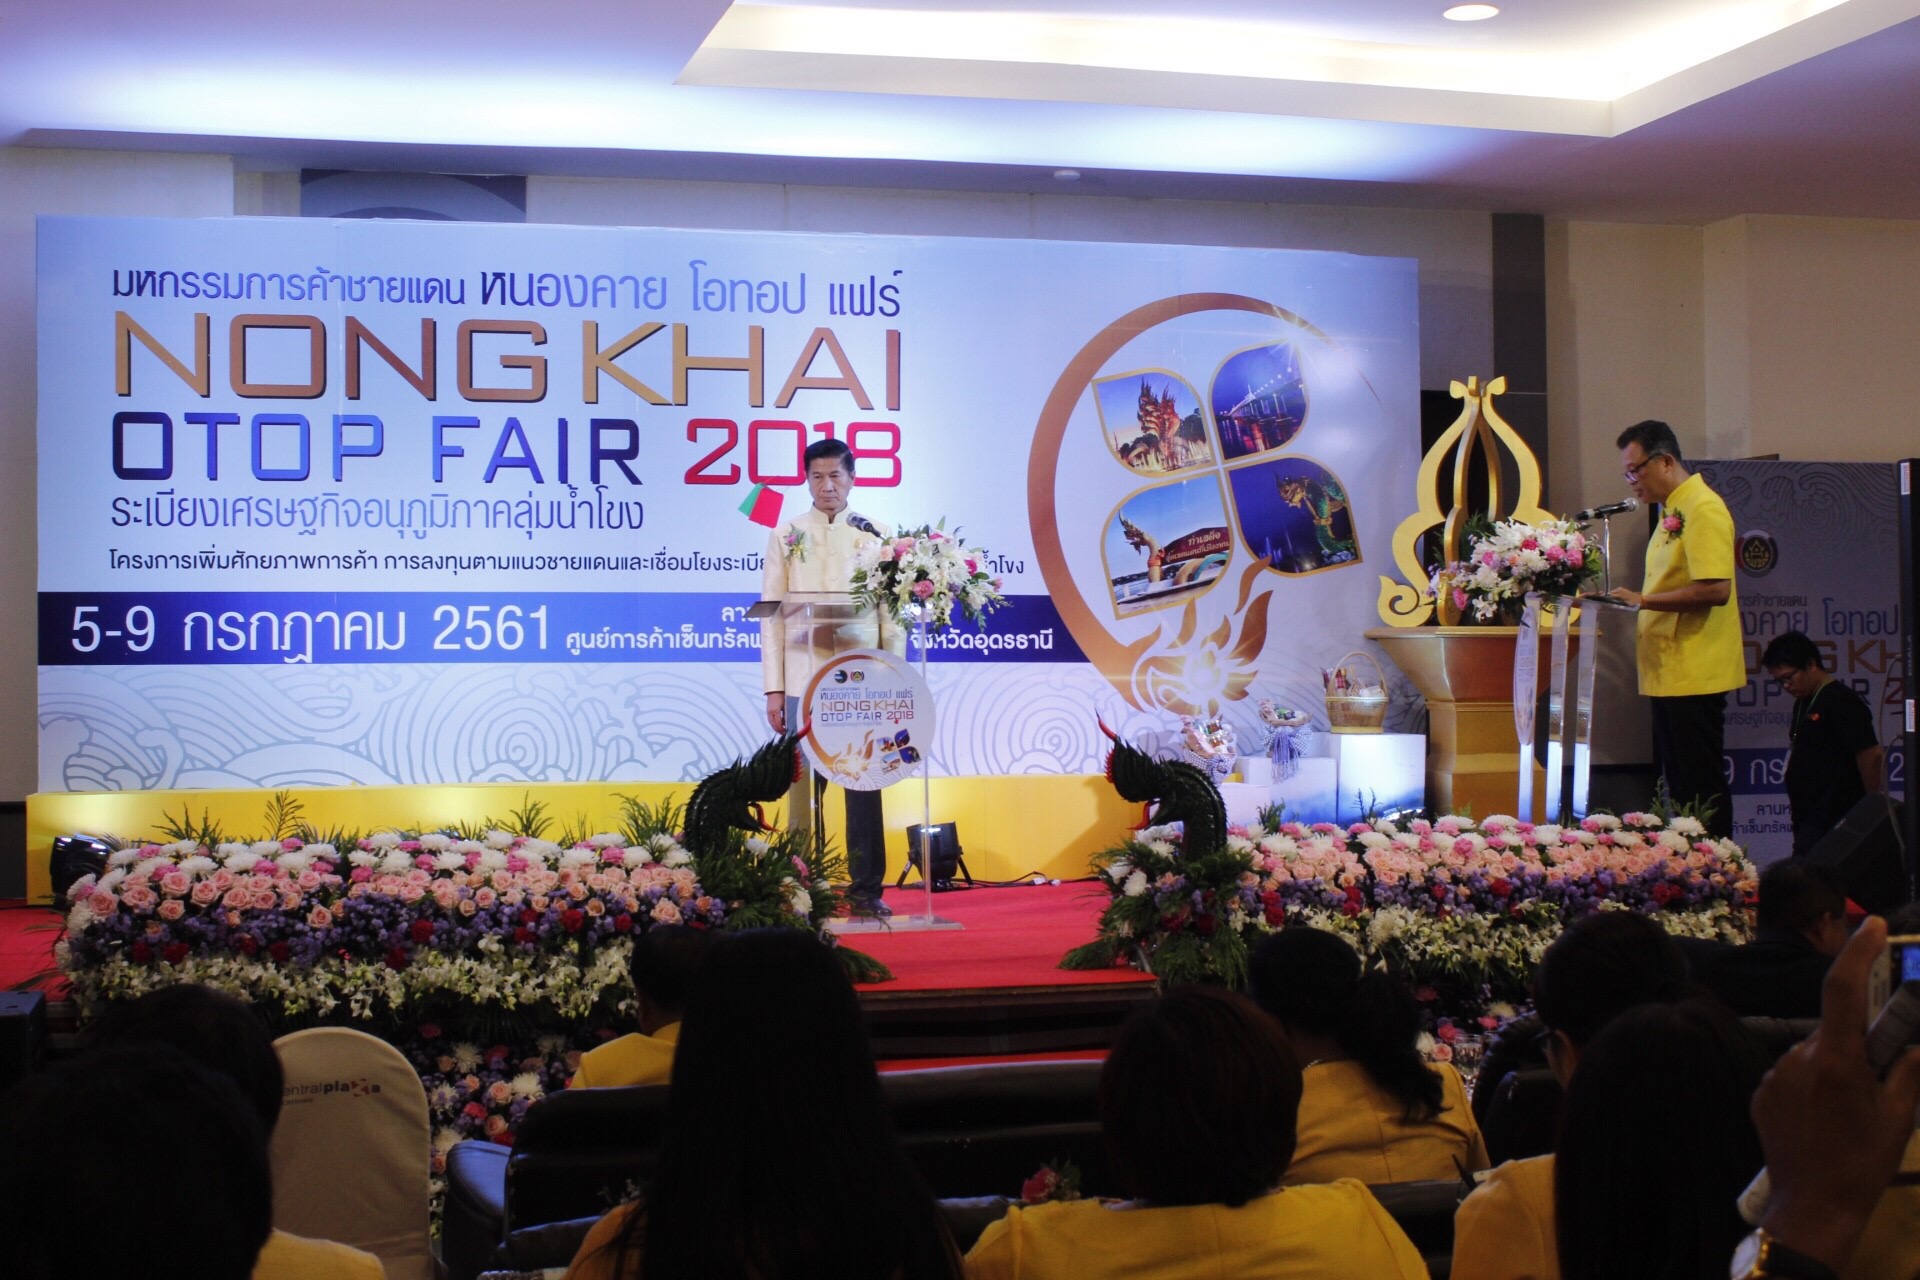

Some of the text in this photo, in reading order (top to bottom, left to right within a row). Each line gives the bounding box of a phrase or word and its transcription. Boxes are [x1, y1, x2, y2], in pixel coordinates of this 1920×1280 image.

[111, 259, 903, 318] มหกรรมการค้าชายแดน หนองคาย โอทอป แฟร์
[114, 310, 901, 412] NONG KHAI
[111, 410, 903, 488] OTOP FAIR 208
[109, 544, 378, 570] โครงการเพิ่มศักยภาพการค้า
[71, 604, 549, 664] 5-9 กรกฎาคม 2561
[566, 623, 762, 656] ศูนย์การค้าเซ็นทรัลพ
[821, 700, 914, 712] NONG KHAI
[821, 711, 914, 721] OTOP FAIR 2018
[283, 1078, 380, 1097] entralplaza
